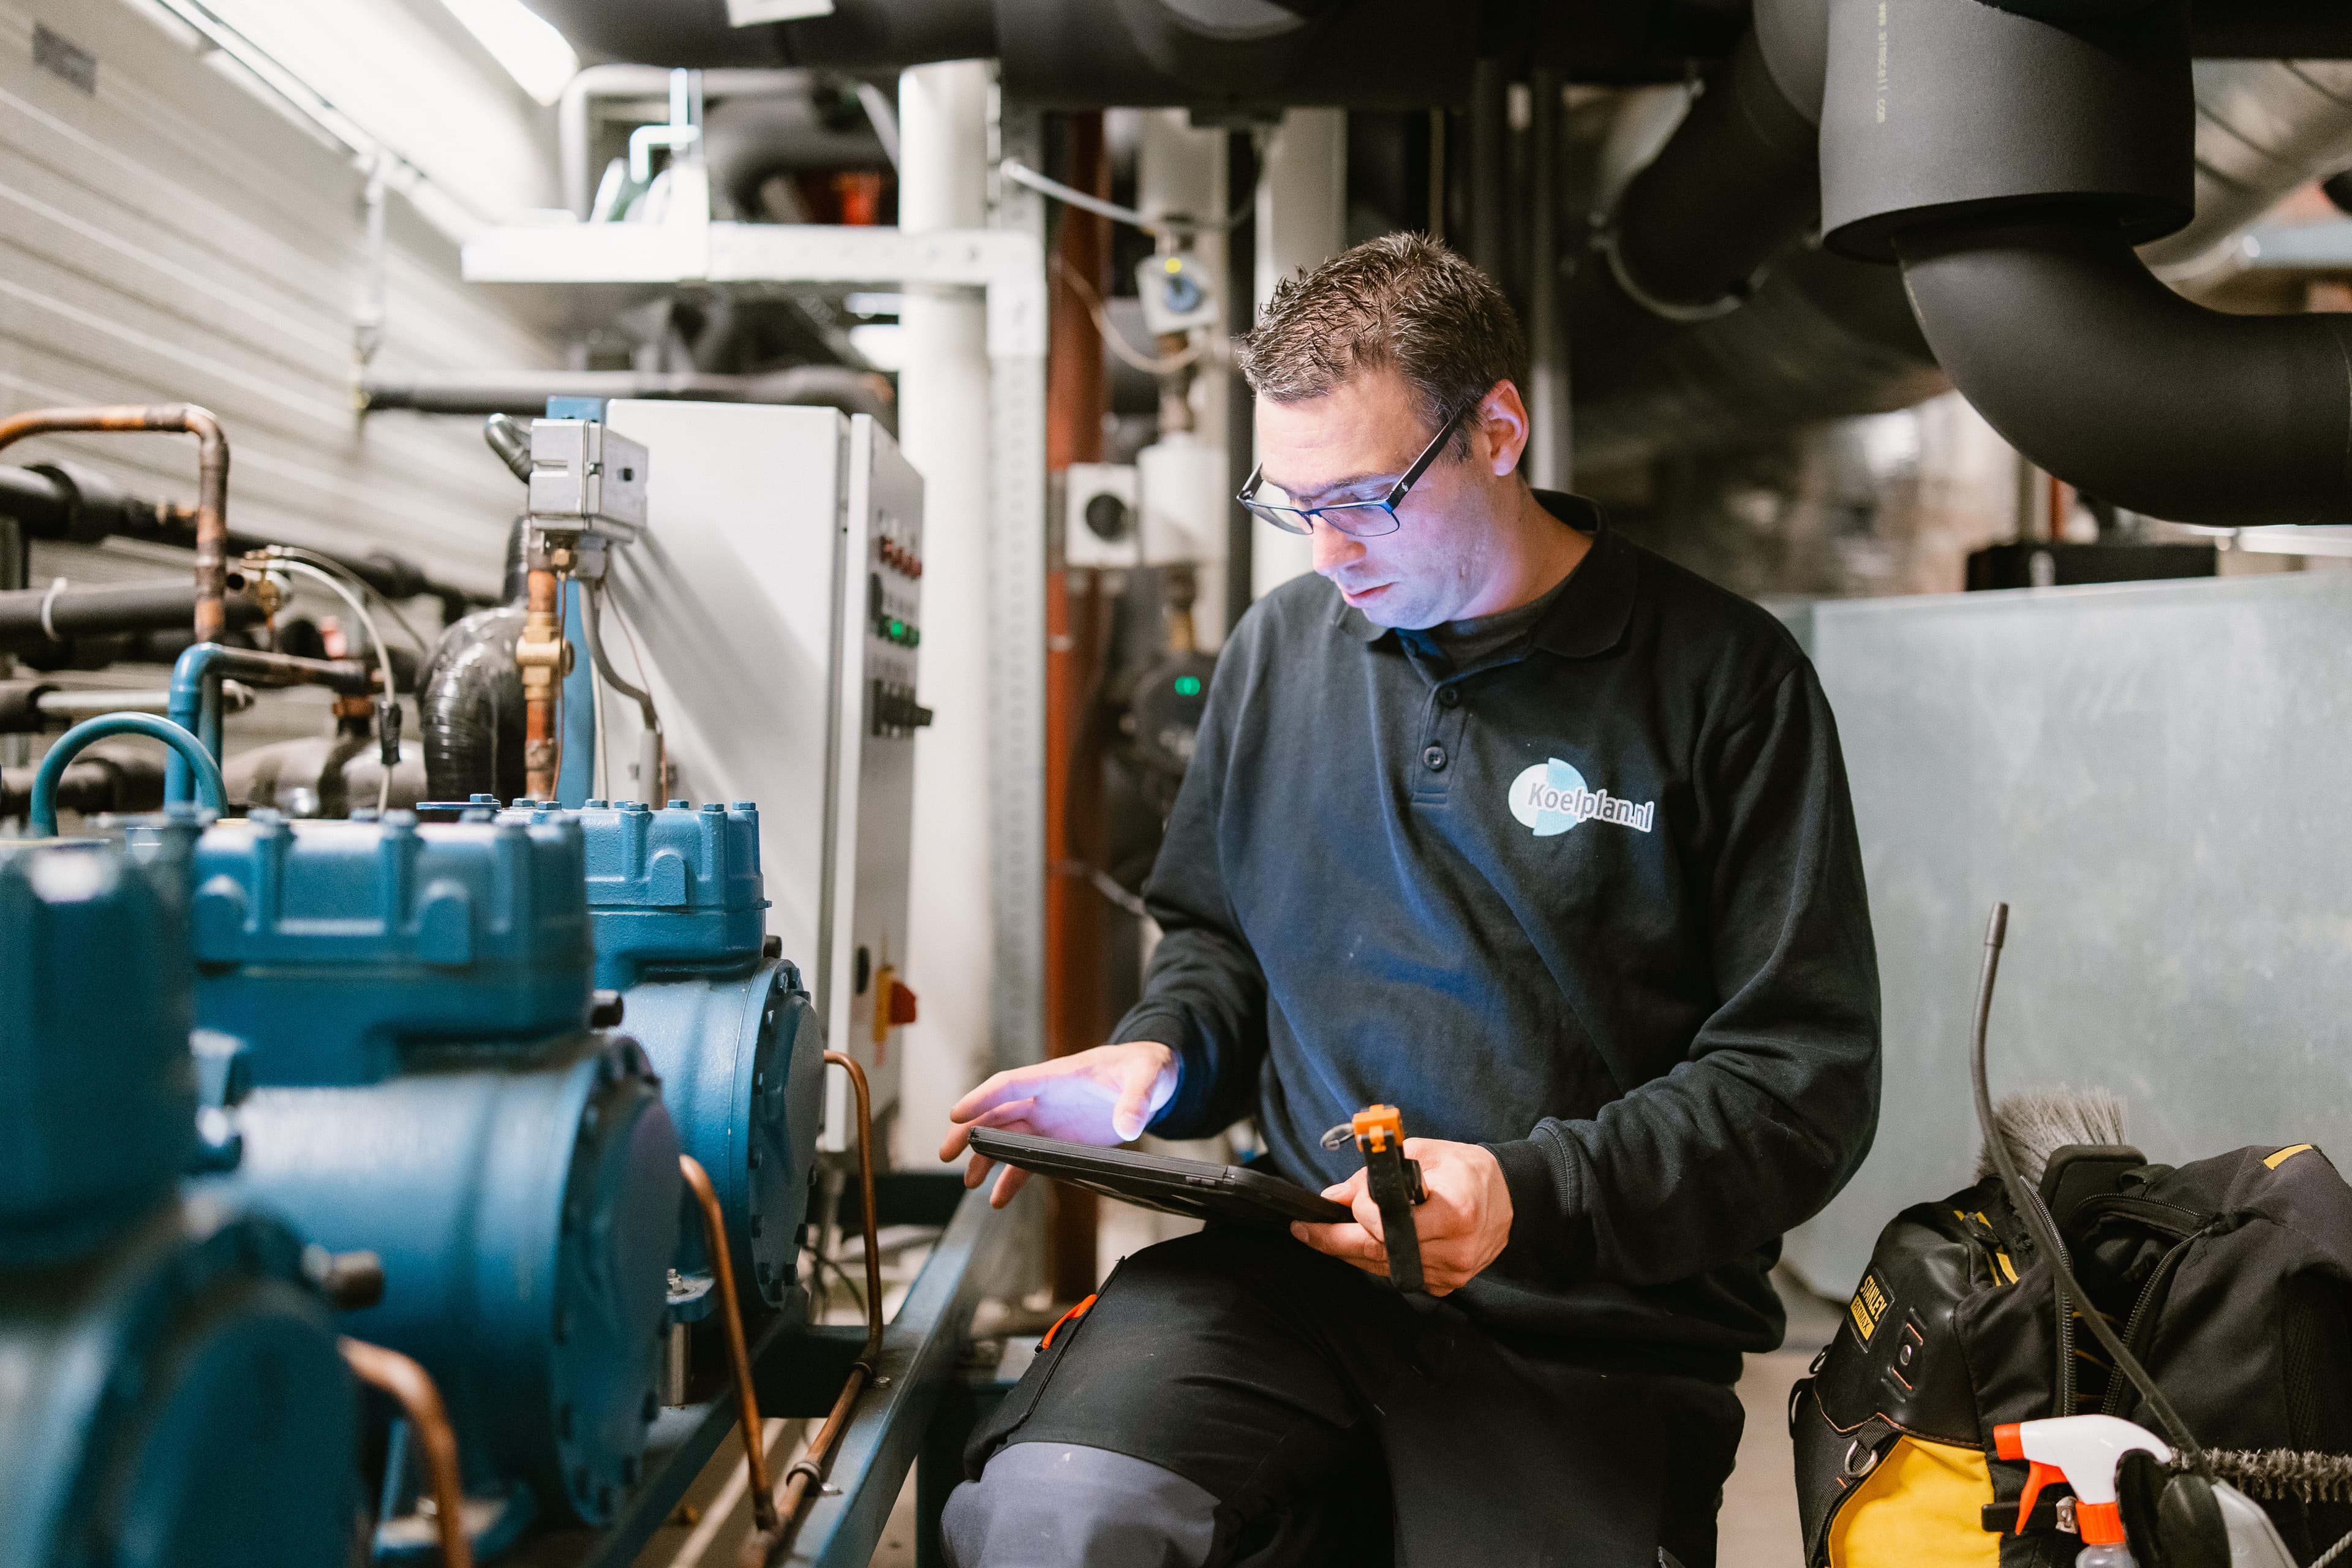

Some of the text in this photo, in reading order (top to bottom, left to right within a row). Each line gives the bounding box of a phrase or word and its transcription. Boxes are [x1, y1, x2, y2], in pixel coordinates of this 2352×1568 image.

[1528, 782, 1653, 830] Koelplan.nl
[1852, 1300, 1870, 1332] FATMAX
[1860, 1275, 1888, 1321] STANLEY
